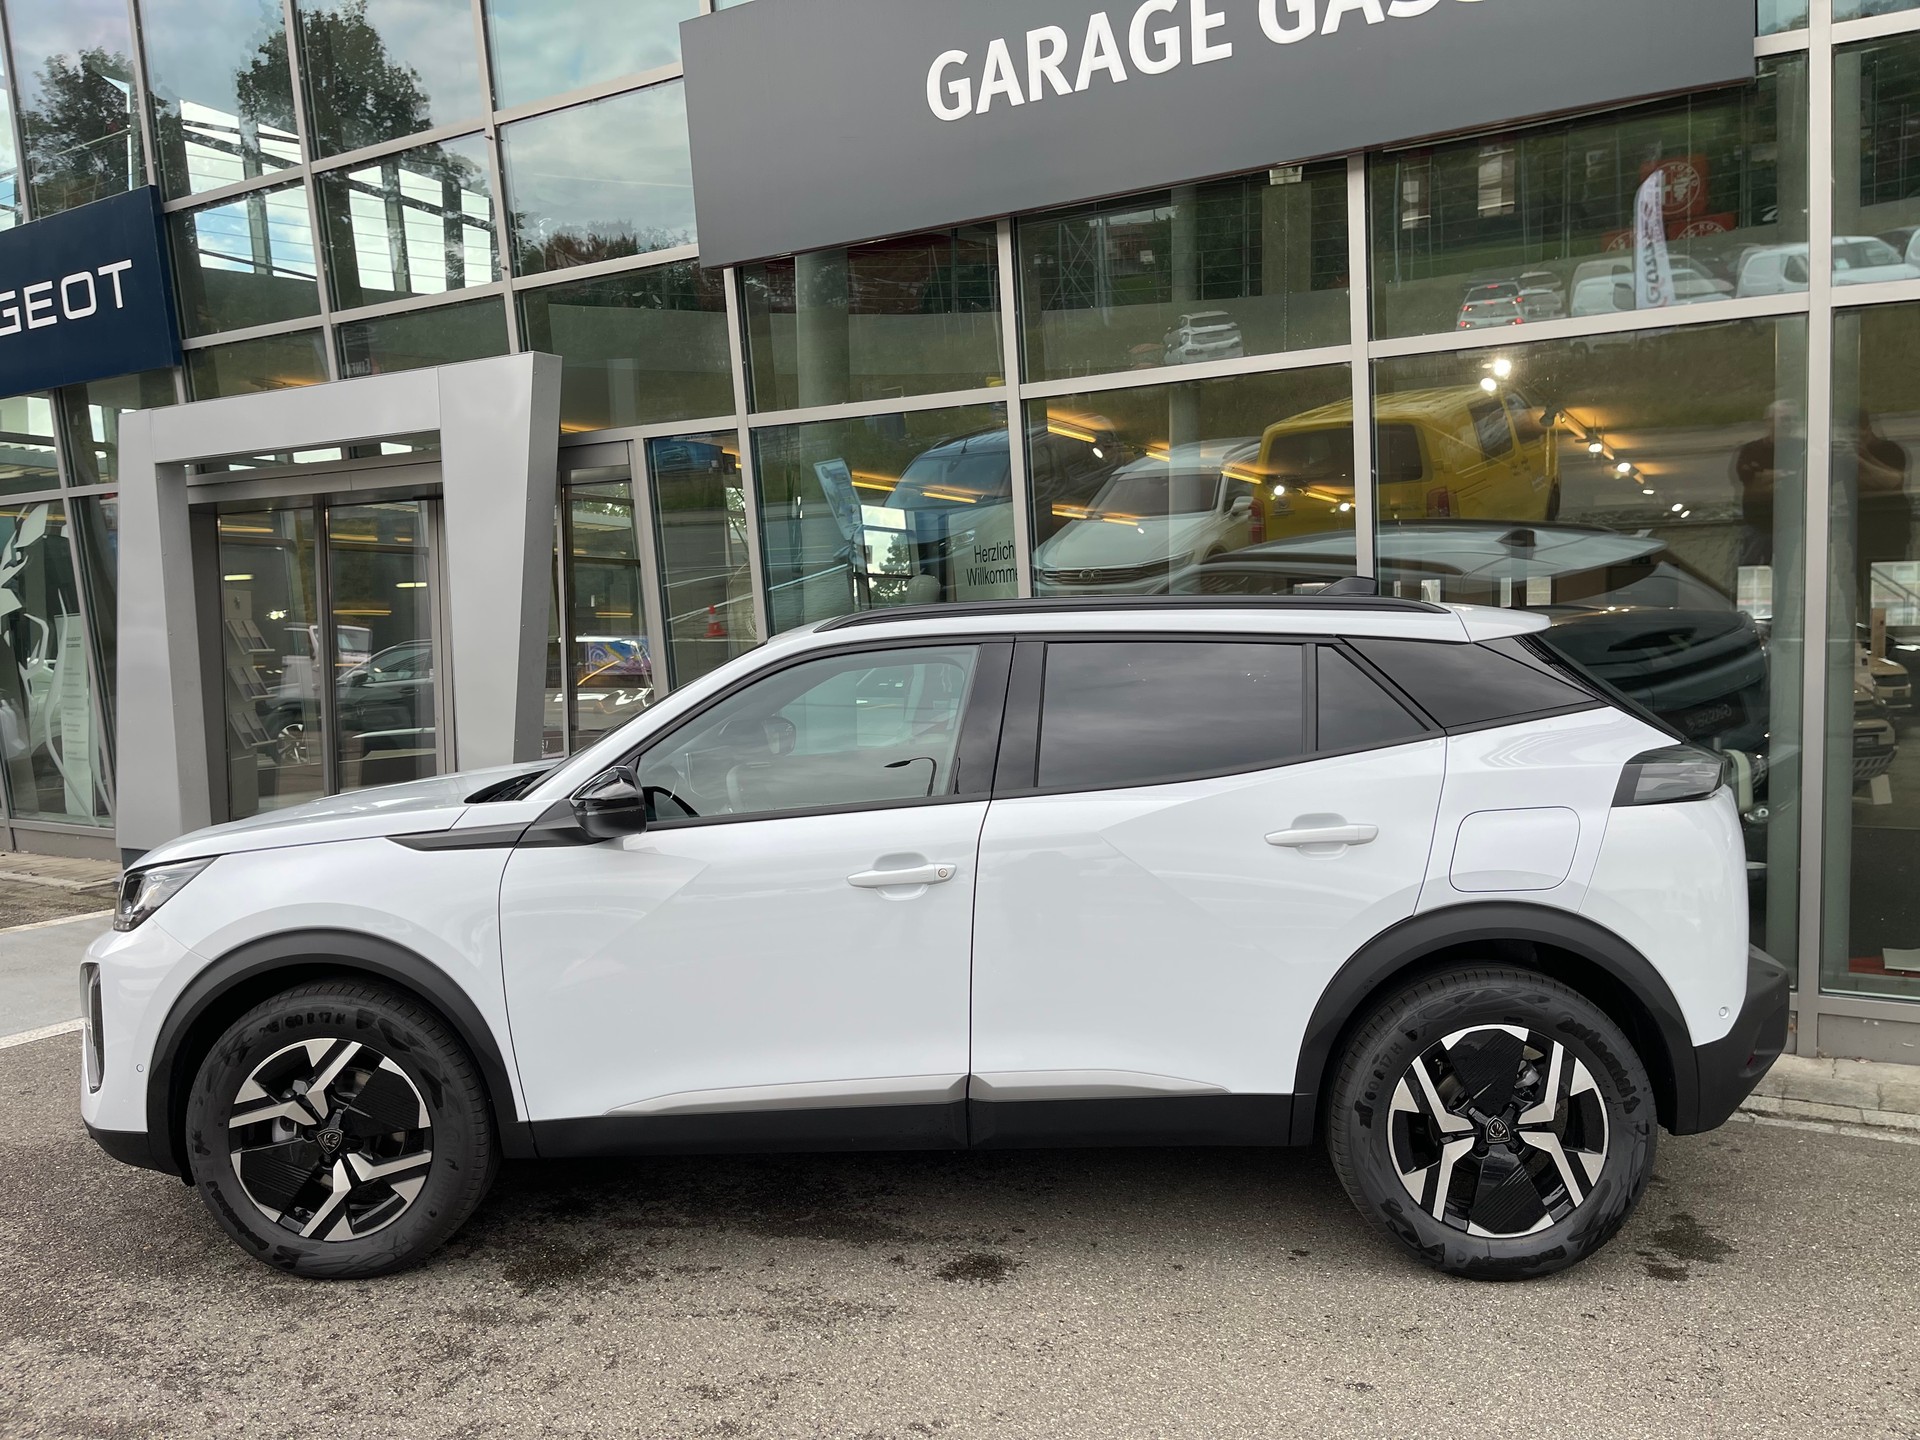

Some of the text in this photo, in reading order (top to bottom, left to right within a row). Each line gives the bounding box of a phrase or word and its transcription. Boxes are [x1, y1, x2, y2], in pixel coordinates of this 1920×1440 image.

[926, 0, 1232, 121] GARAGE
[0, 259, 132, 336] GEOT
[974, 540, 1014, 563] Herzlich
